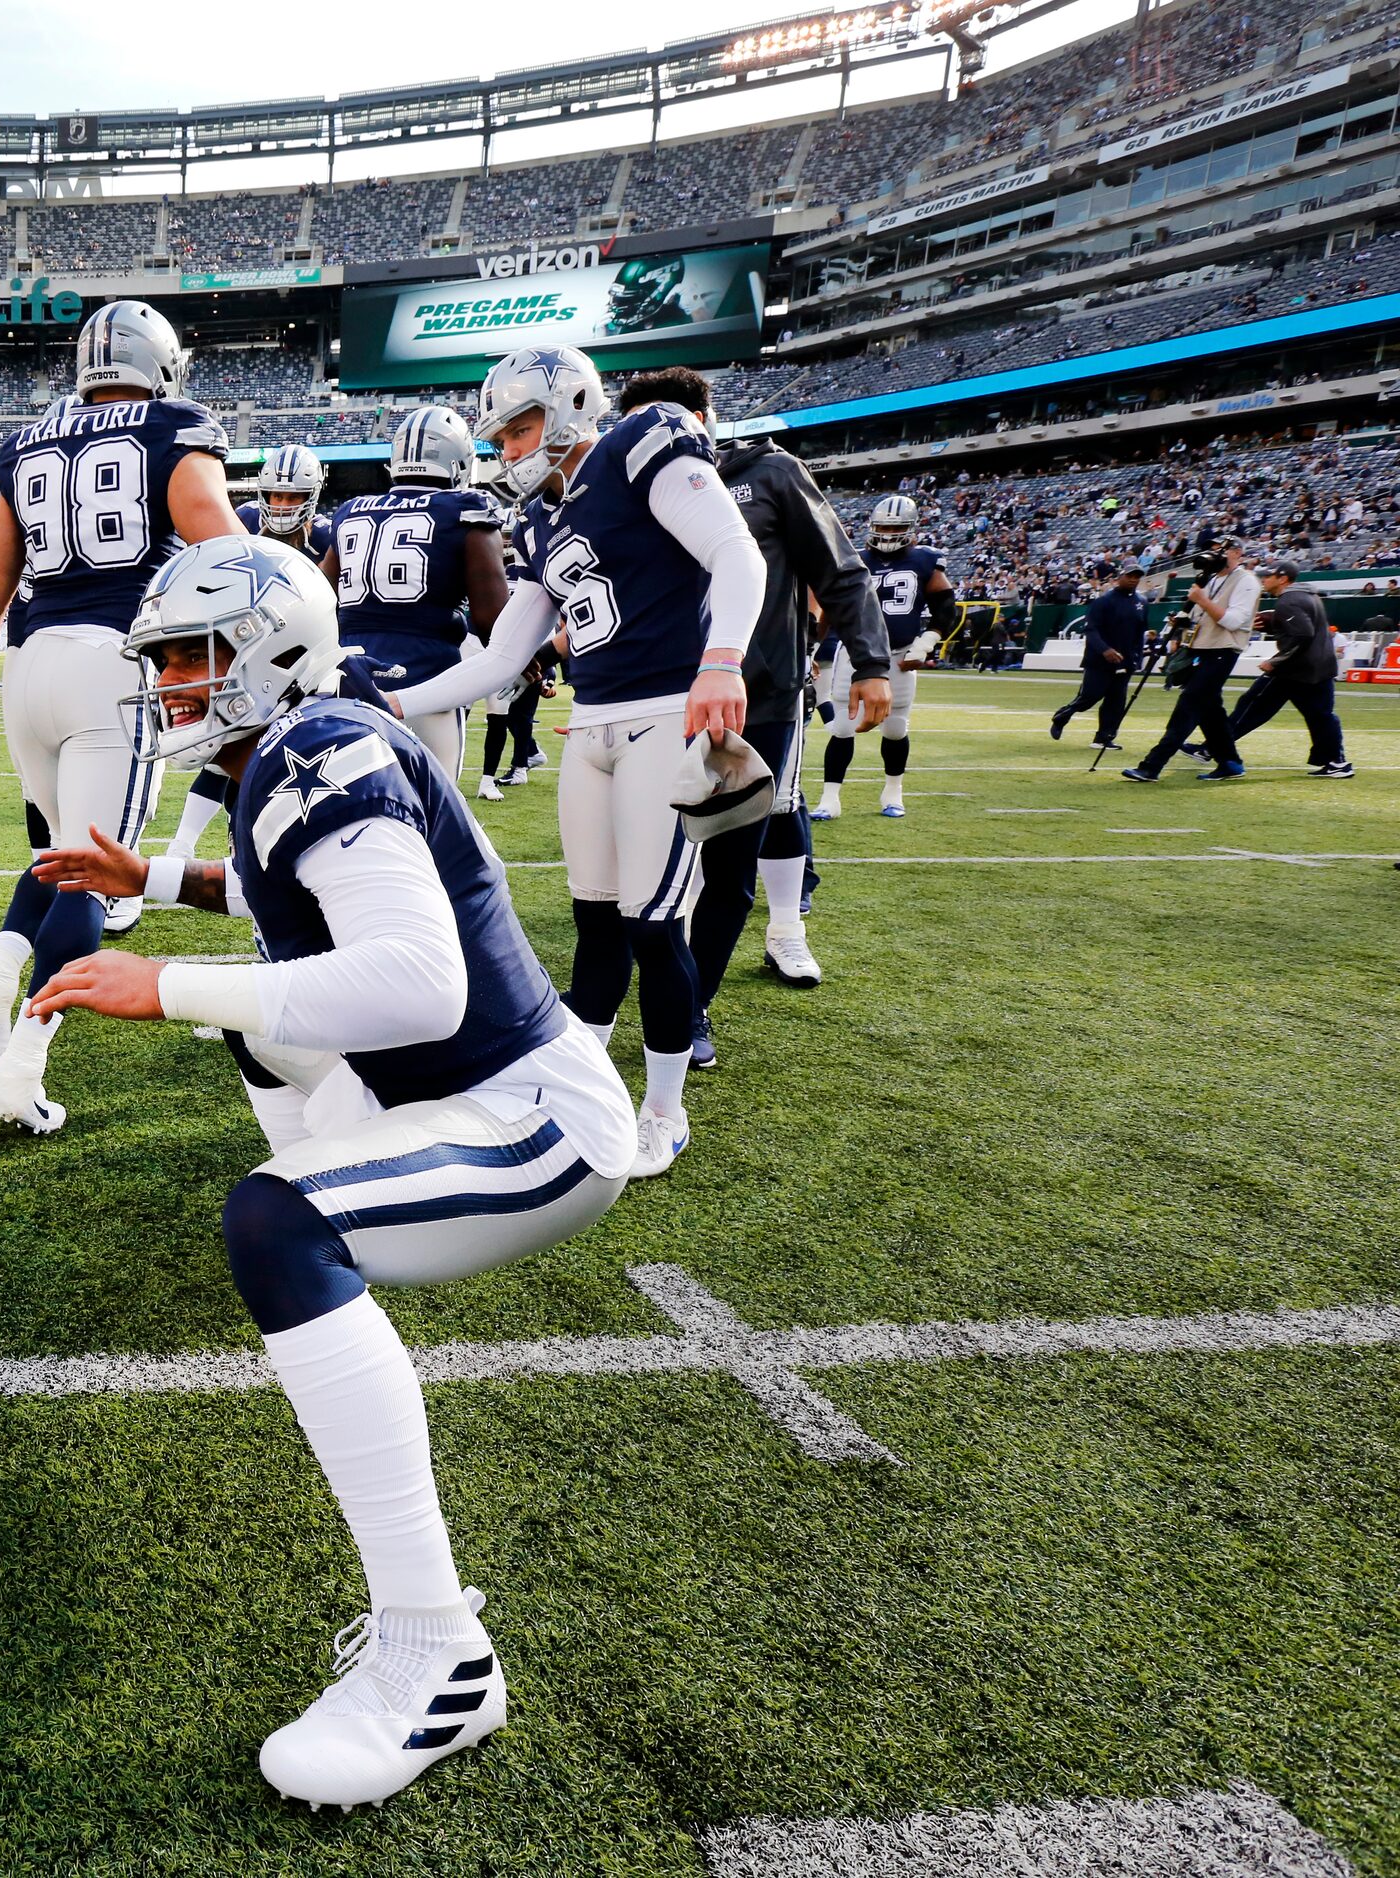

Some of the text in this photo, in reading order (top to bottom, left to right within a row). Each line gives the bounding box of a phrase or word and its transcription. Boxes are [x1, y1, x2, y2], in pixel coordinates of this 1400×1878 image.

[1124, 80, 1311, 151] 68 KEVIN MAWAE
[879, 172, 1036, 228] 28 CURTIS MARTIN
[214, 271, 257, 282] SUPER
[259, 269, 297, 279] BOWL
[476, 242, 600, 279] verizon
[639, 260, 680, 283] JETS
[230, 276, 298, 287] CHAMPIONS
[414, 292, 563, 318] PREGAME
[423, 307, 578, 331] WARMUPS
[83, 370, 120, 383] COWBOYS
[1217, 394, 1275, 414] MetLife
[16, 400, 149, 450] CRAWFORD
[13, 434, 151, 579] 98
[337, 512, 436, 607] 96
[542, 533, 622, 658] 6
